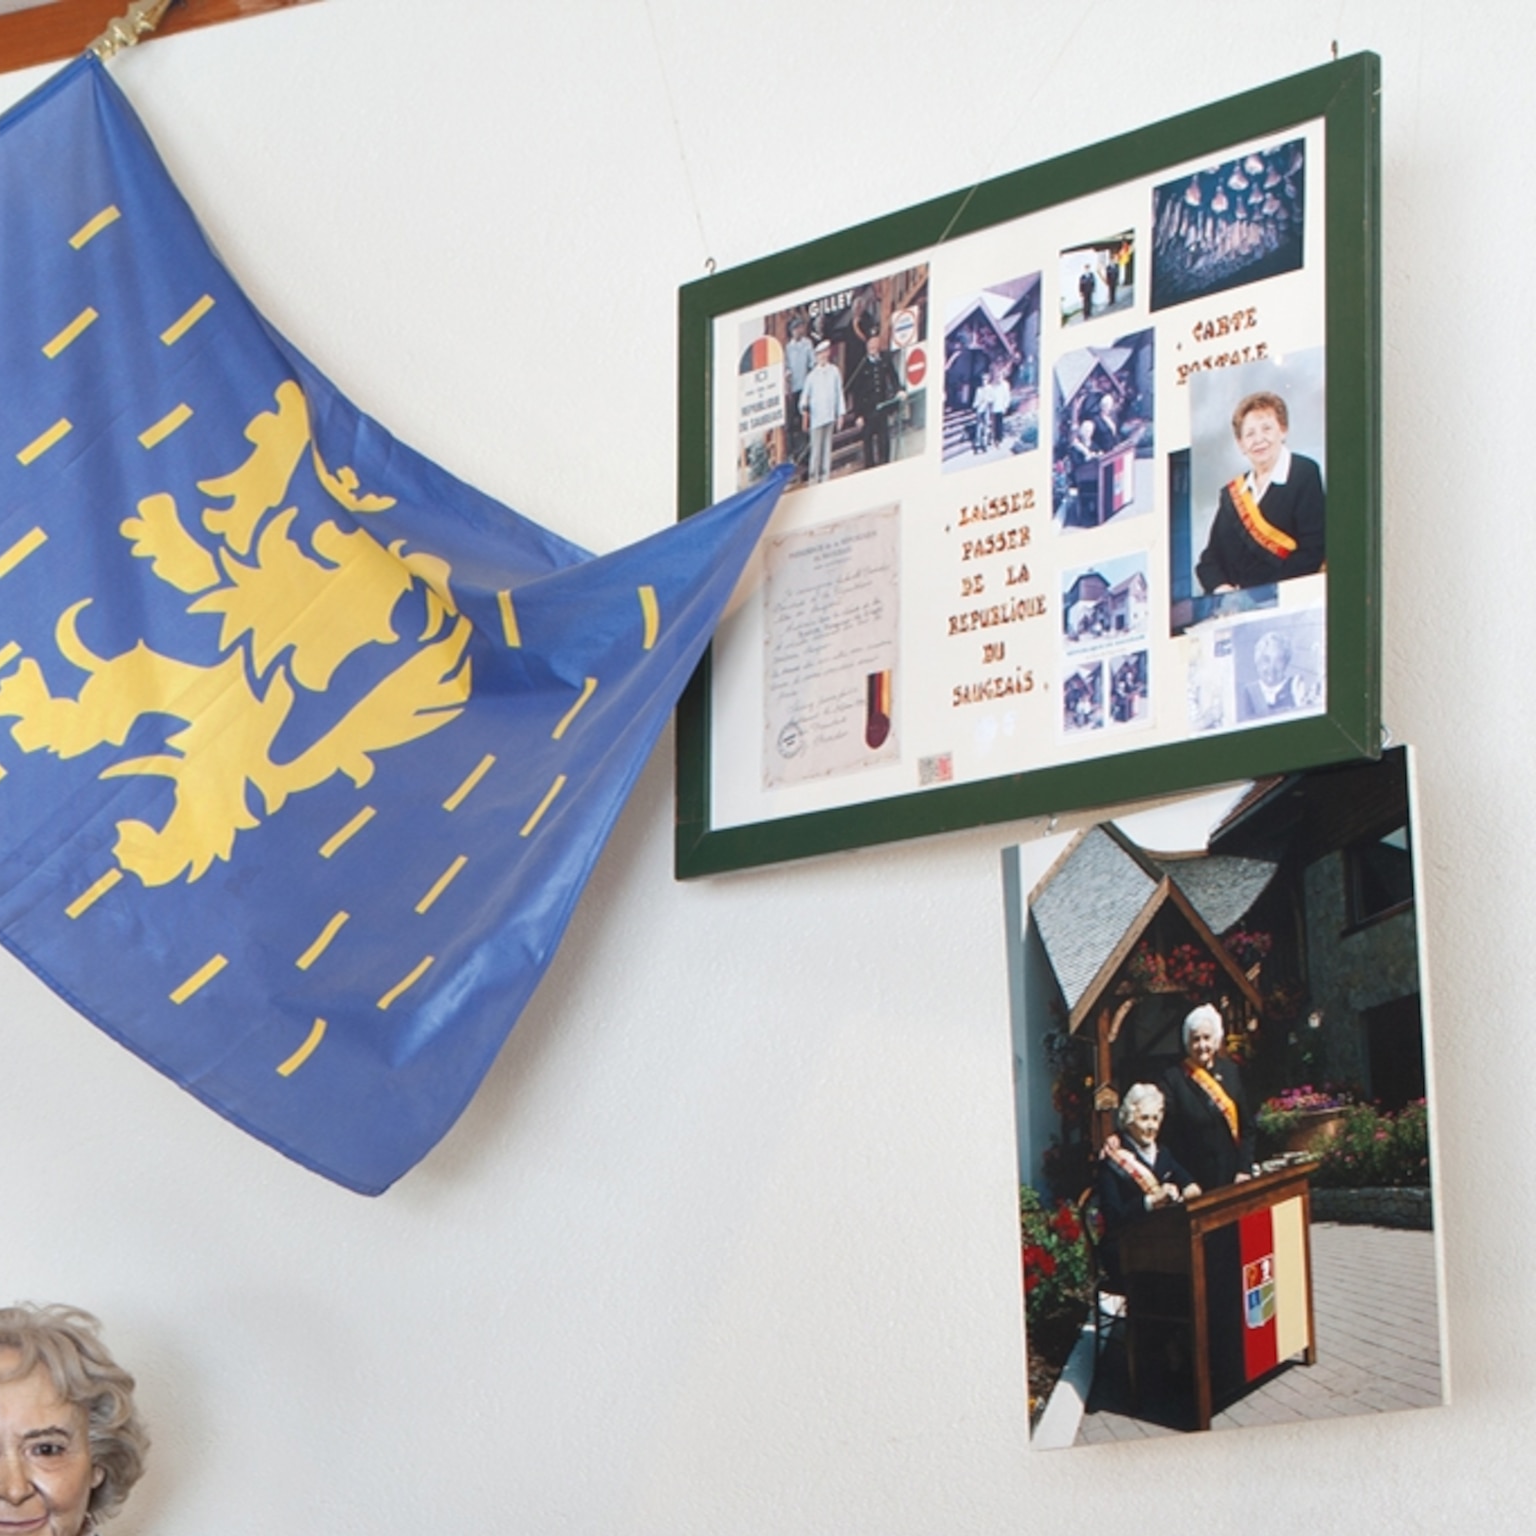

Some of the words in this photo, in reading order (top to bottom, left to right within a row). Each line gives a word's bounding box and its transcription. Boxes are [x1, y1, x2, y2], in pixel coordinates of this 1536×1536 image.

[809, 291, 854, 317] GILLEY
[1192, 306, 1257, 342] CARTE
[962, 525, 1030, 561] PASSER
[962, 573, 984, 596] DE
[1005, 562, 1030, 586] LA
[982, 641, 1005, 664] DU
